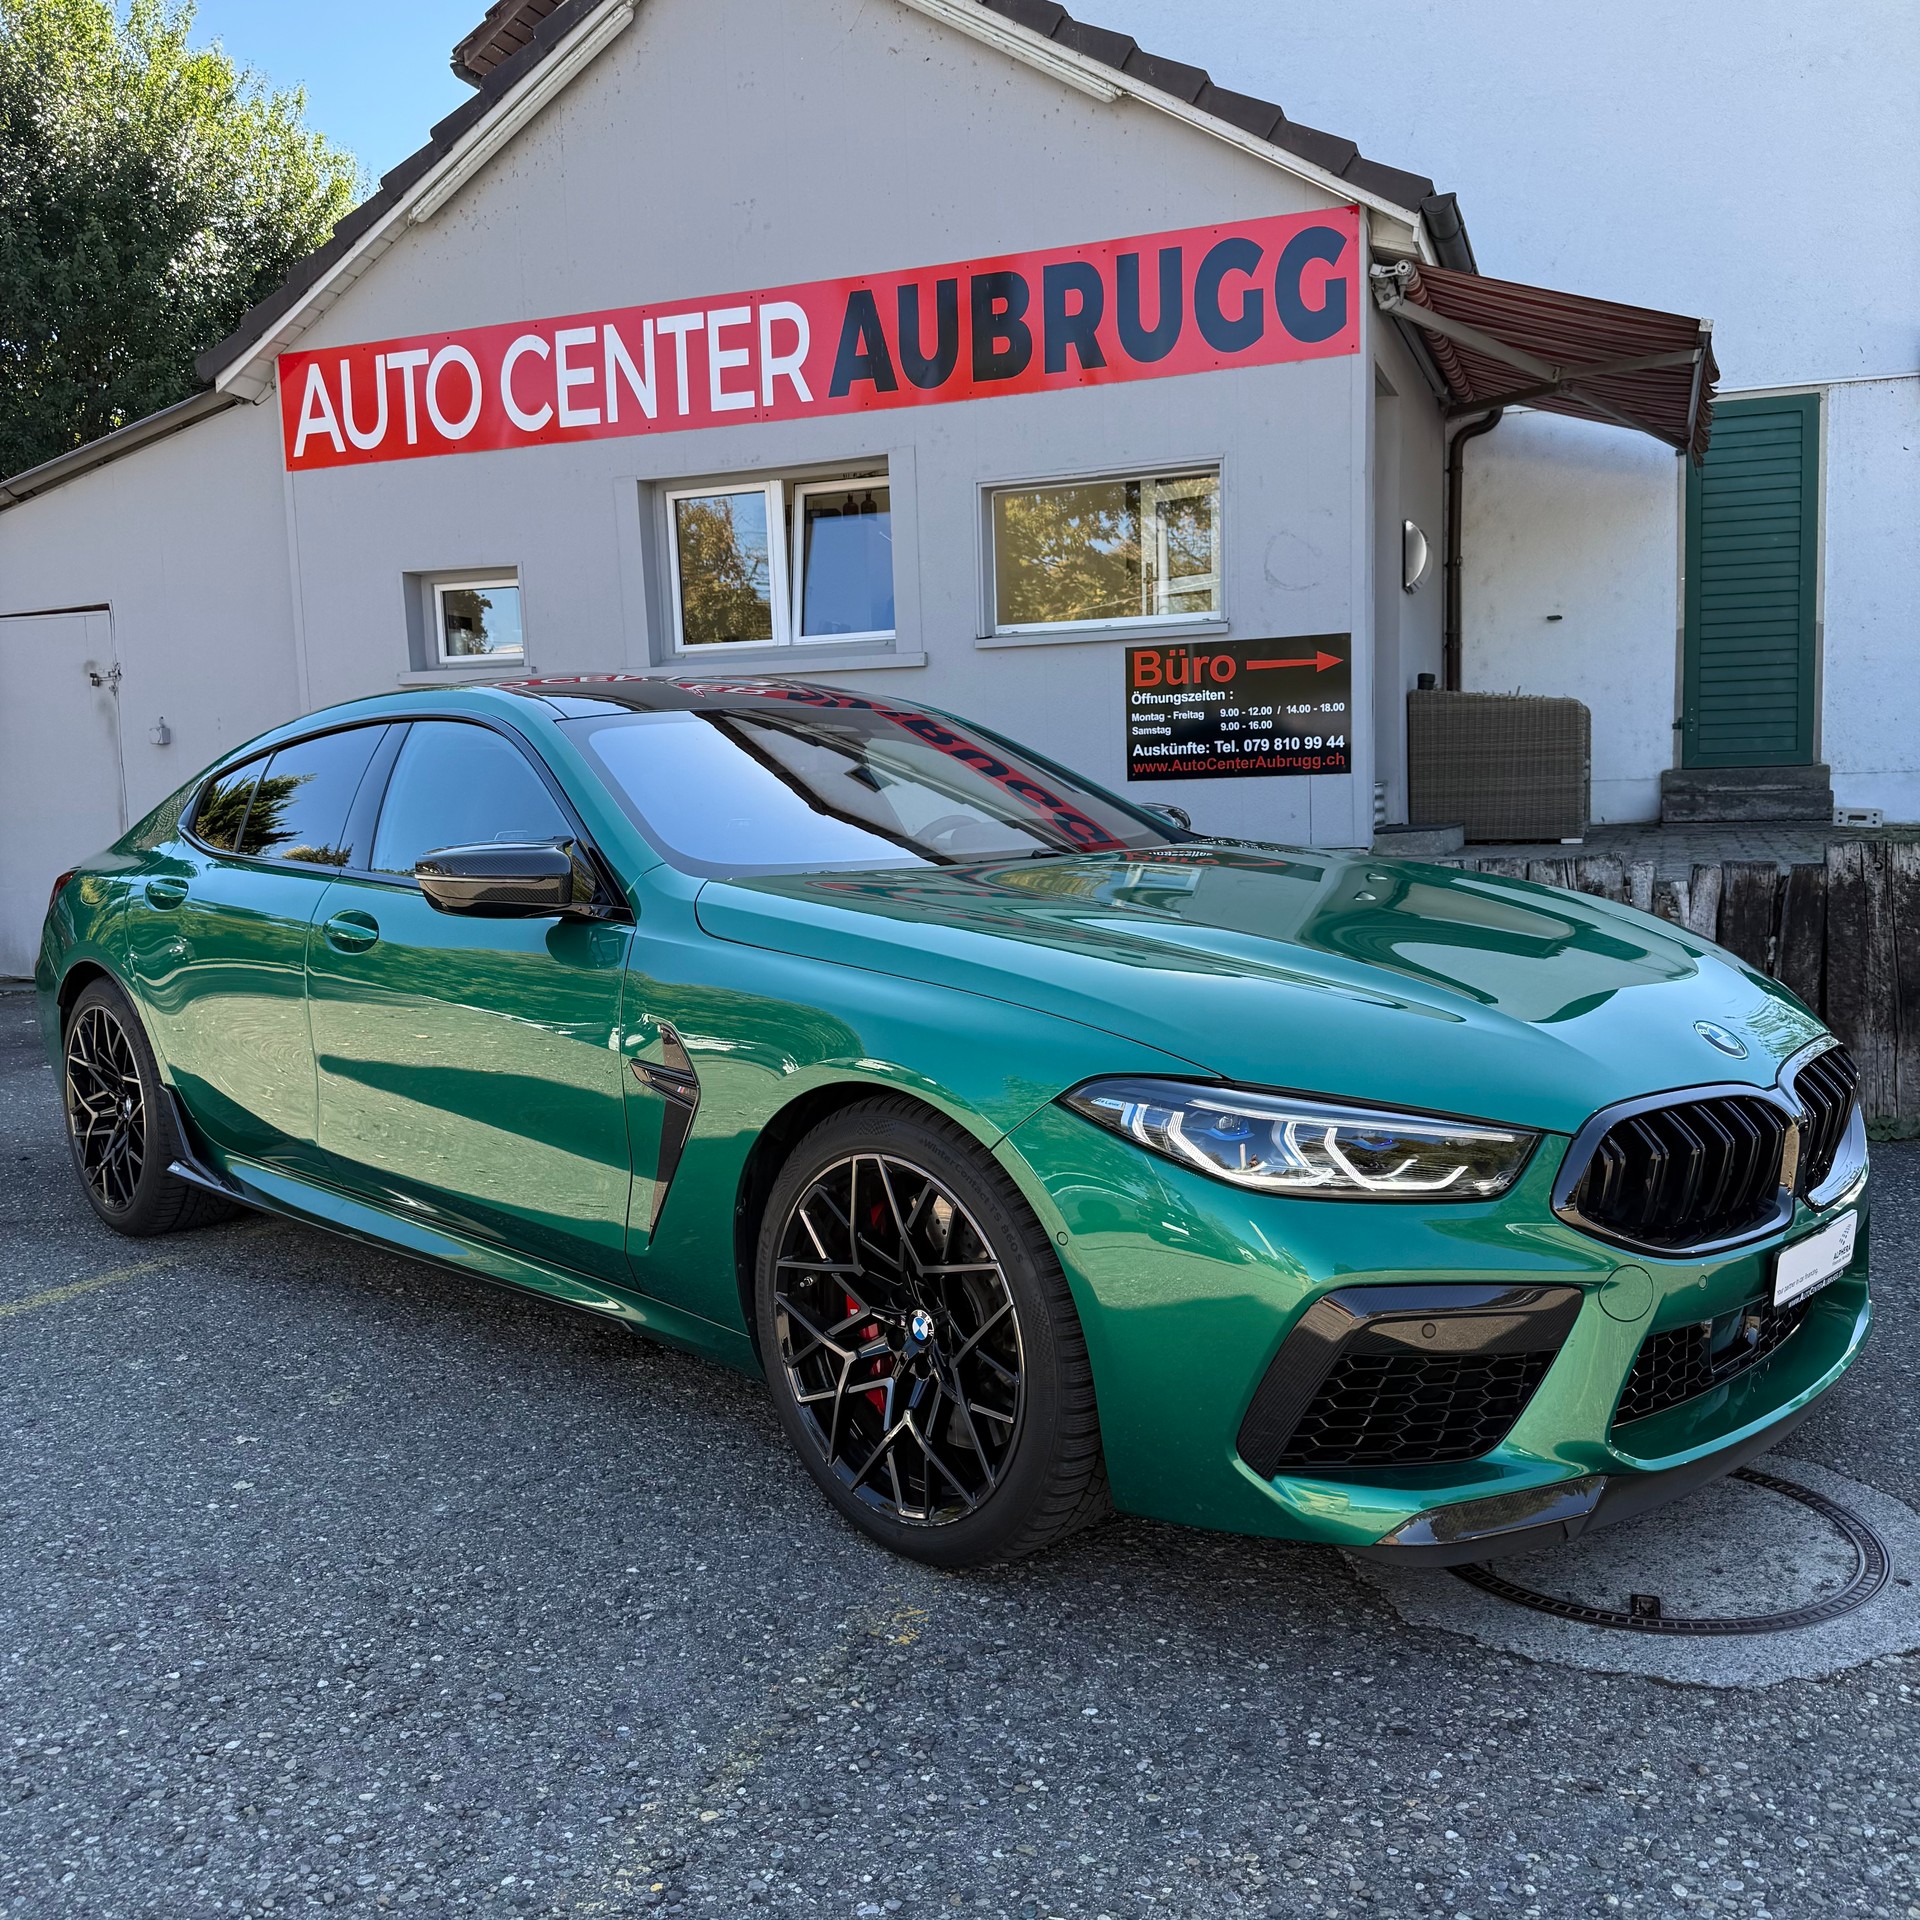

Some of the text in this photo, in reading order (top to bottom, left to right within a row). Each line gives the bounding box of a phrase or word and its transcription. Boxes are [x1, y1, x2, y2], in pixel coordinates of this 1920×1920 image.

[293, 226, 1348, 458] AUTO CENTER AUBRUGG
[1133, 649, 1237, 687] Büro
[1131, 690, 1226, 705] Öffnungszeiten
[1131, 713, 1165, 722] Montag
[1173, 711, 1205, 720] Freitag
[1219, 708, 1239, 717] 9.00
[1248, 706, 1273, 716] 12.00
[1286, 704, 1311, 714] 14.00
[1320, 702, 1345, 712] 18.00
[1132, 726, 1172, 736] Samstag
[1220, 722, 1240, 731] 9.00
[1248, 720, 1273, 730] 16.00
[1132, 735, 1345, 757] Auskünfte: Tel. 079 810 99 44
[1133, 752, 1345, 774] www.AutoCenterAubrugg.ch
[990, 1203, 1002, 1222] TS
